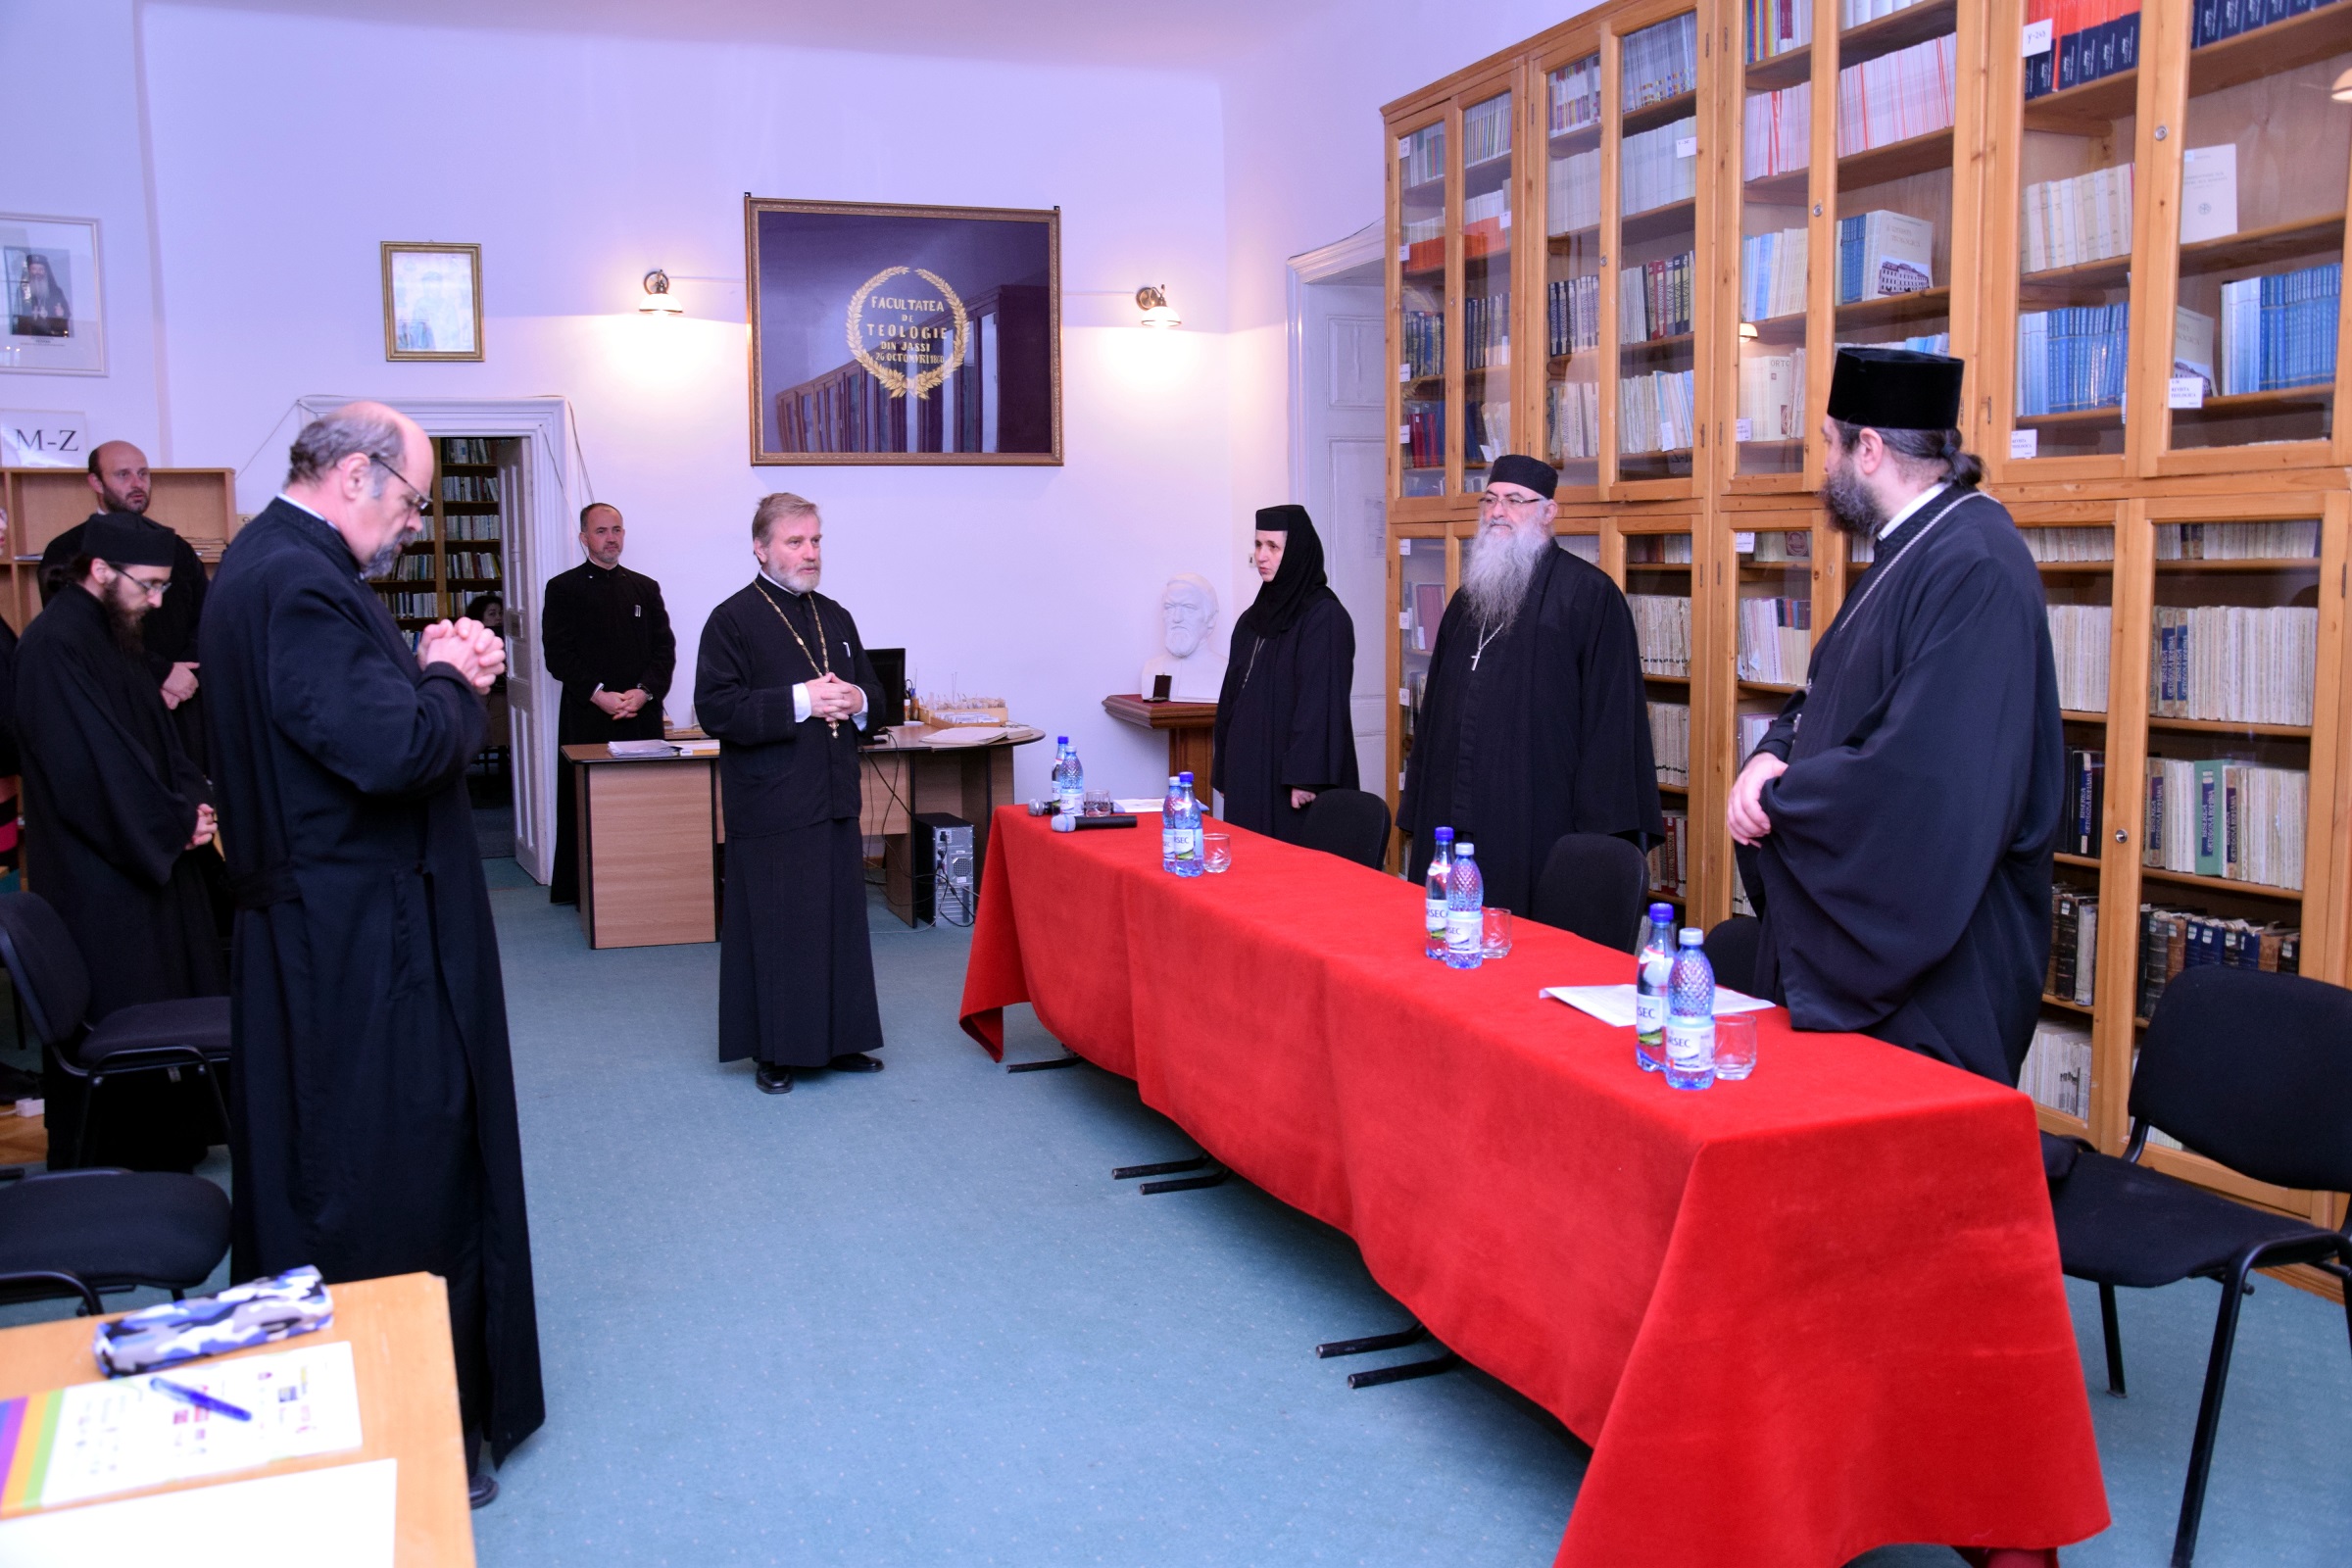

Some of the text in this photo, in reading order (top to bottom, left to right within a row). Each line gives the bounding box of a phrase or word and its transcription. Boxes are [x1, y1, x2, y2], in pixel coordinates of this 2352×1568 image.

[871, 296, 945, 312] FACULTATEA
[866, 323, 948, 339] TEOLOGIE
[881, 341, 931, 352] DIN JASSI
[16, 428, 79, 452] M-Z
